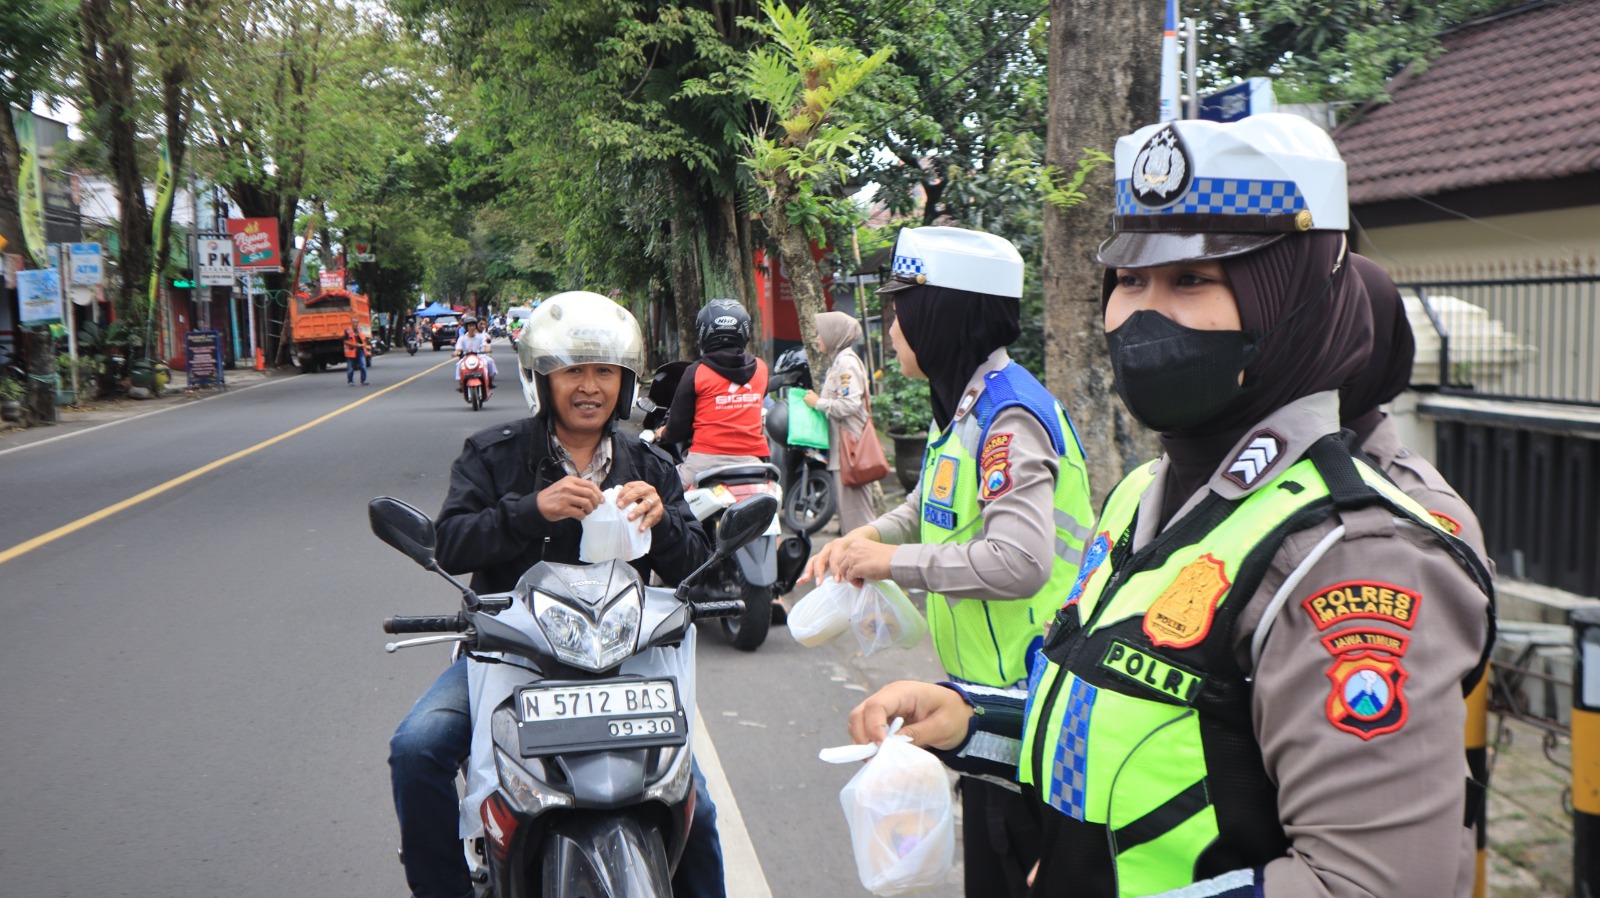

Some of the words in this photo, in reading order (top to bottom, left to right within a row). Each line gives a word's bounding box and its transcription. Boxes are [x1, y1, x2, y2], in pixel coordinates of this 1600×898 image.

[76, 264, 99, 274] ATM
[715, 393, 761, 404] EIGER
[925, 506, 951, 526] POLRI
[1311, 586, 1411, 614] POLRES
[1319, 602, 1409, 623] MALANG
[1156, 613, 1187, 633] POLISI
[1334, 633, 1364, 648] JAWA
[1364, 634, 1400, 650] TIMUR
[1107, 644, 1198, 701] POLRI
[525, 695, 540, 717] N
[553, 691, 612, 716] 5712
[625, 688, 668, 711] BAS
